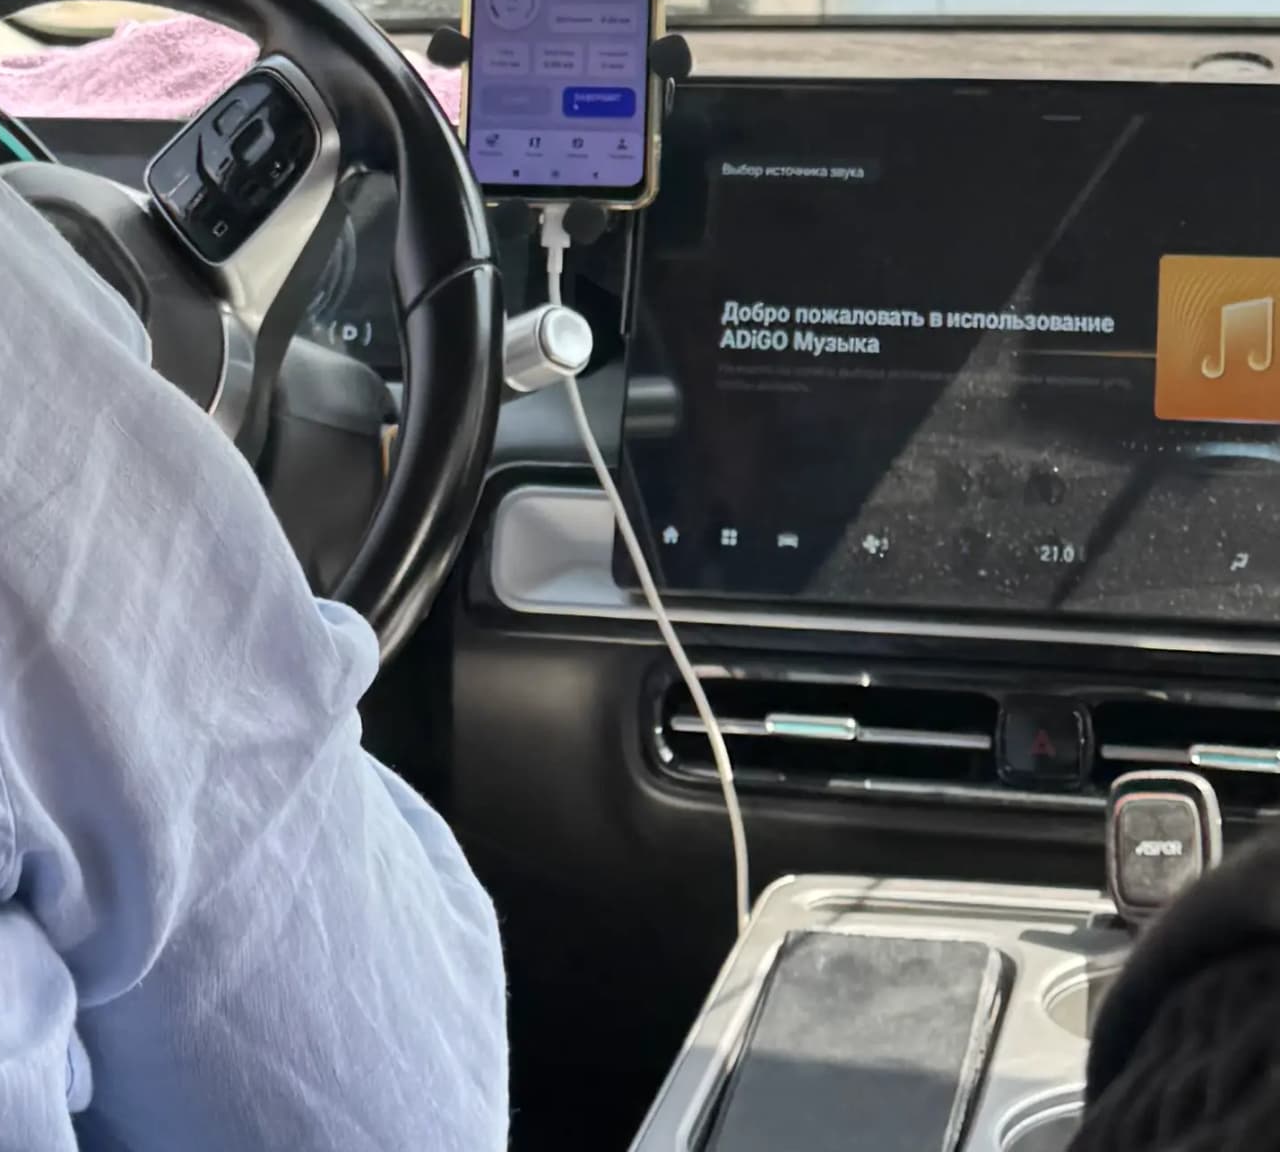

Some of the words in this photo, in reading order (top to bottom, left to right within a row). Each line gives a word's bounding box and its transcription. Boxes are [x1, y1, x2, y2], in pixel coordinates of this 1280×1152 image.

[721, 161, 764, 179] Выбор
[765, 165, 828, 178] источника
[829, 167, 865, 181] звука
[720, 300, 791, 327] Добро
[794, 306, 925, 328] пожаловать
[929, 311, 944, 328] в
[946, 311, 1116, 334] использование
[719, 328, 789, 351] ADiGO
[793, 330, 881, 357] Музыка
[1039, 543, 1075, 564] 21.0
